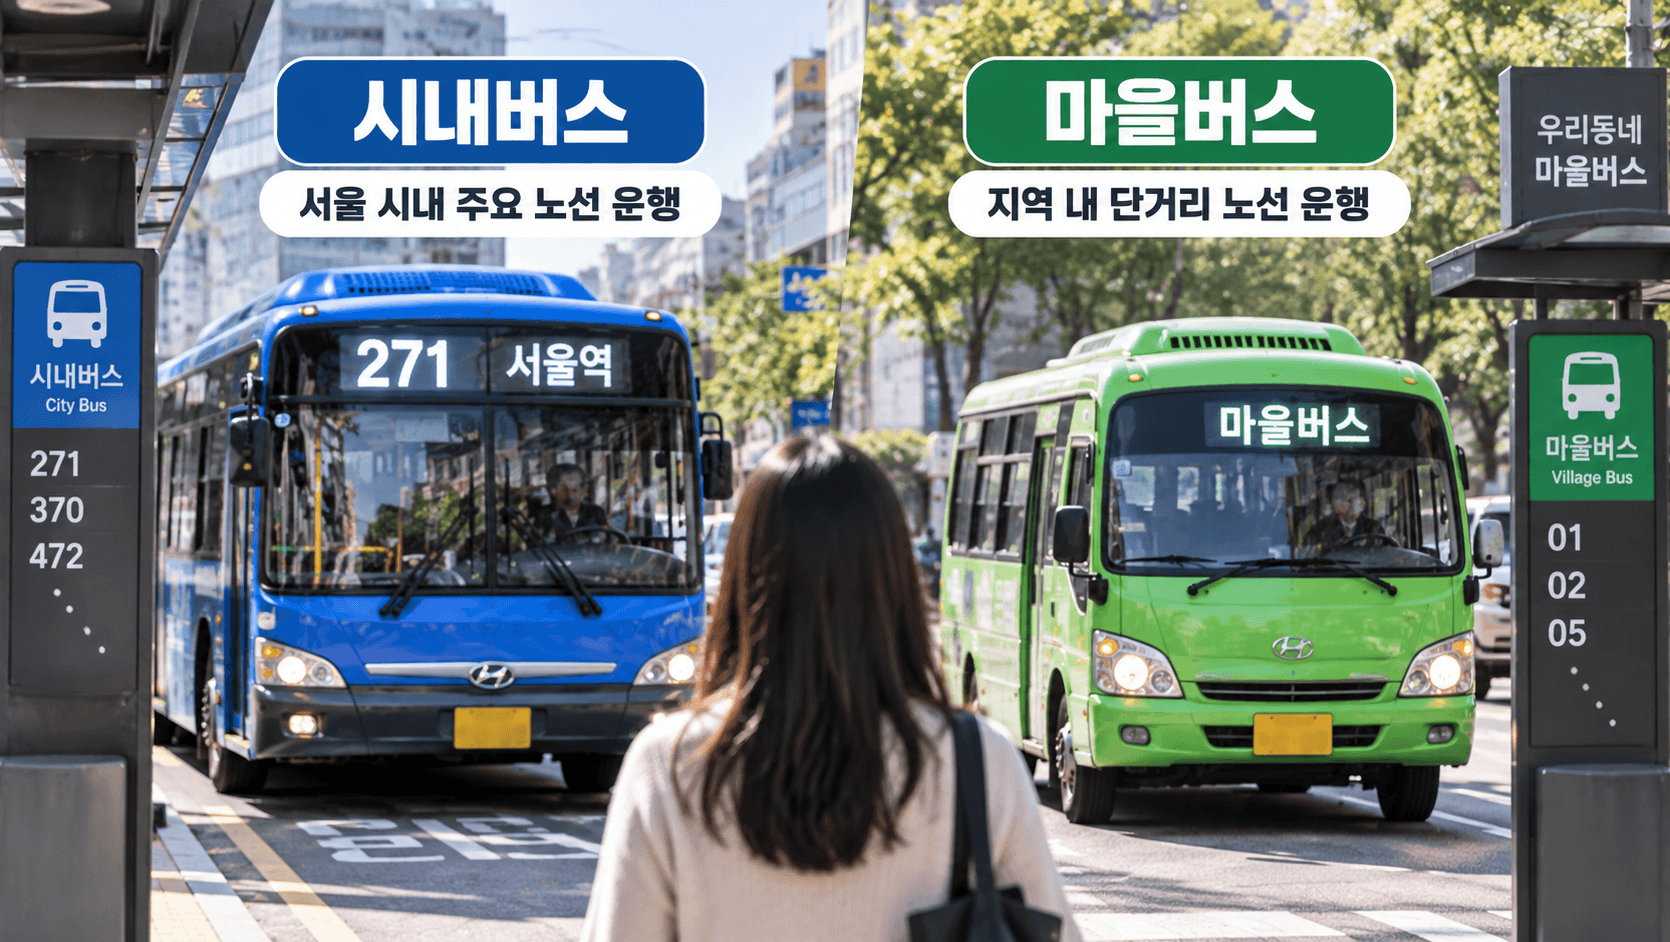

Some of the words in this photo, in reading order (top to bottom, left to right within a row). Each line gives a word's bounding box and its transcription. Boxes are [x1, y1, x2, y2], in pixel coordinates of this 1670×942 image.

[1537, 114, 1642, 145] 우리동네
[30, 362, 124, 390] 시내버스
[357, 338, 448, 388] 271
[506, 342, 612, 388] 서울역
[45, 397, 75, 415] City
[79, 397, 107, 412] Bus
[30, 450, 79, 477] 271
[1551, 469, 1602, 488] Village
[1606, 470, 1633, 485] Bus
[30, 496, 84, 524] 370
[1548, 523, 1581, 552] 01
[29, 542, 84, 569] 472
[1548, 571, 1586, 600] 02
[1548, 618, 1587, 647] 05
